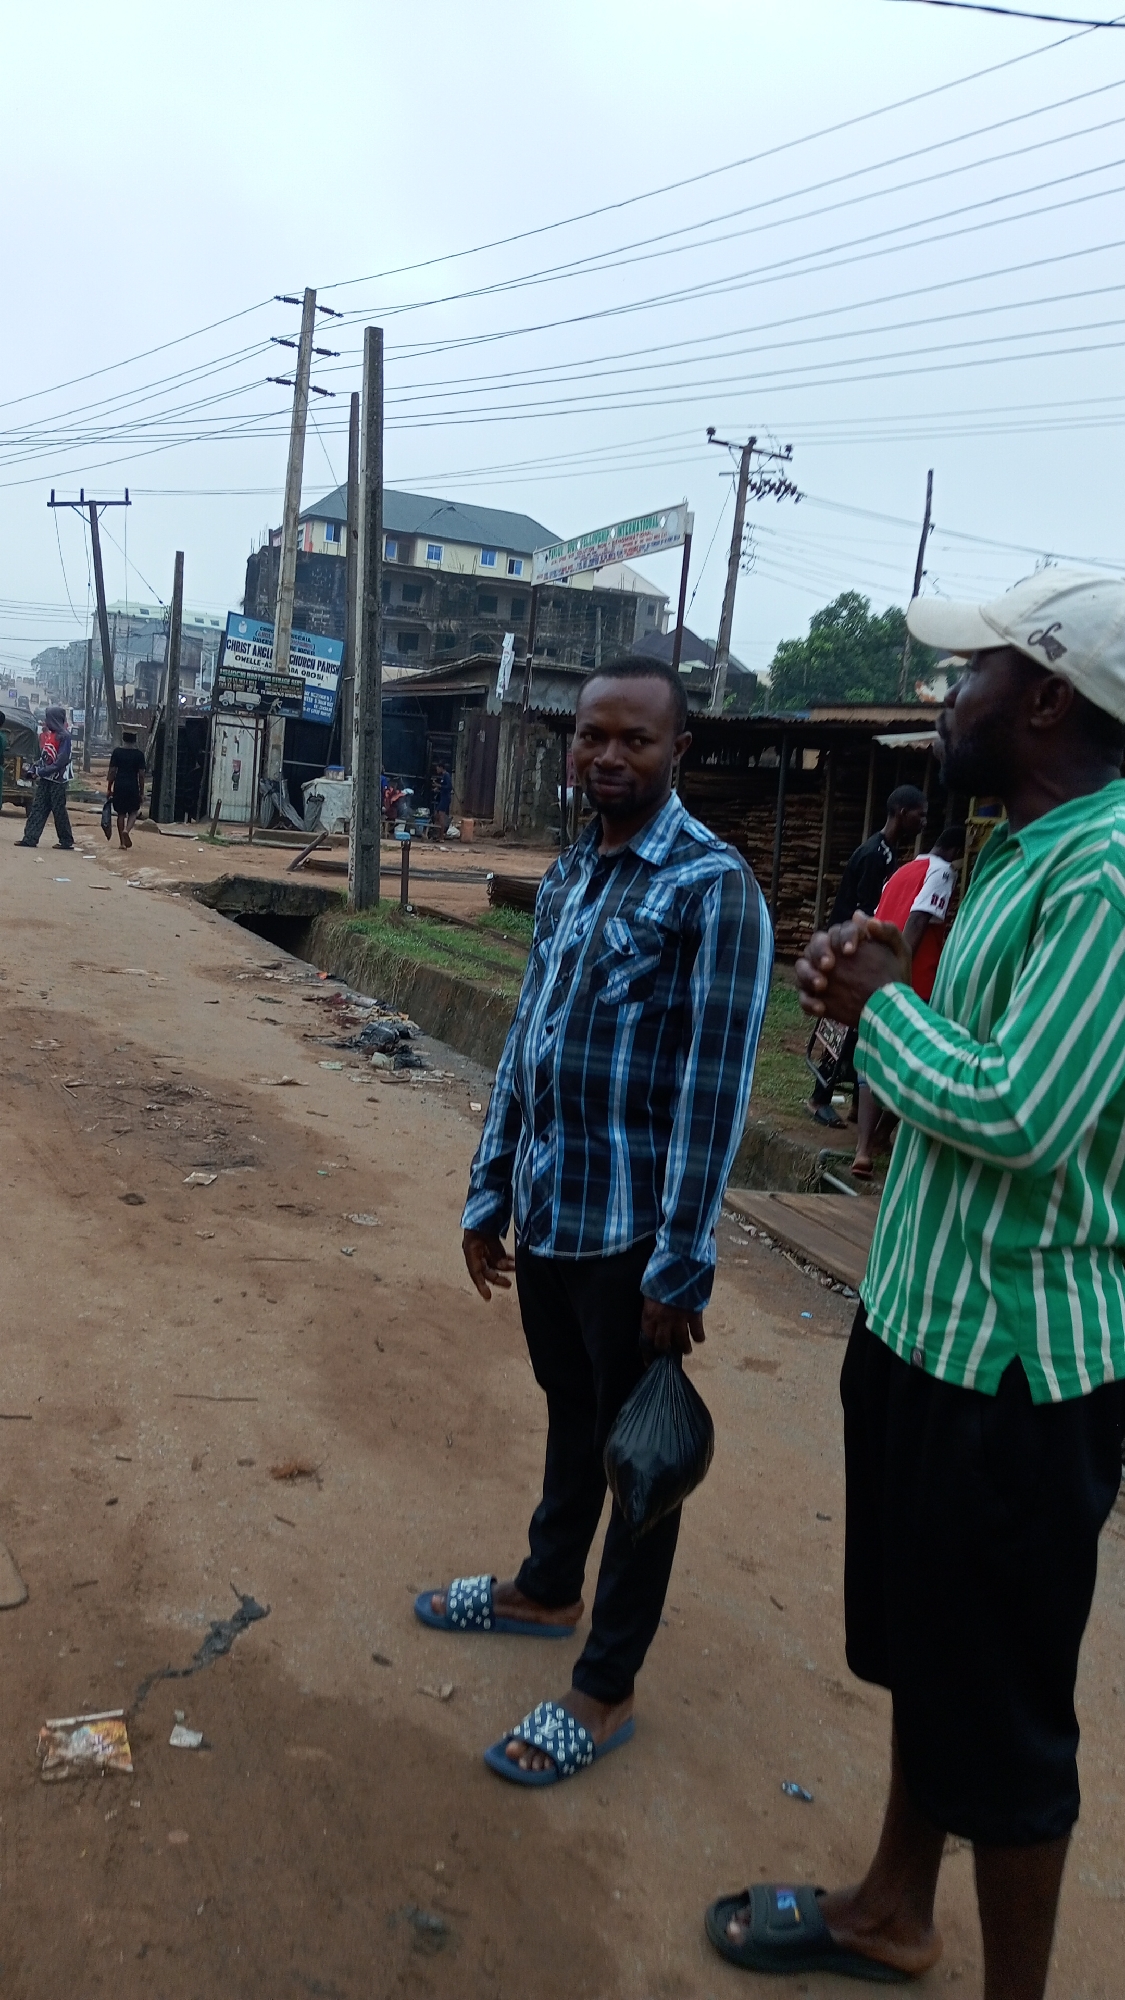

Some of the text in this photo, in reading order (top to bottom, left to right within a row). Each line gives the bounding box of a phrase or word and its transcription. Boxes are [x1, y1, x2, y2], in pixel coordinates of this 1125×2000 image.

[617, 515, 659, 535] INTERNATIONAL
[226, 638, 251, 653] CHRIST
[252, 645, 273, 660] ANGLI
[289, 654, 315, 669] CHURCH
[317, 659, 340, 675] PARISH
